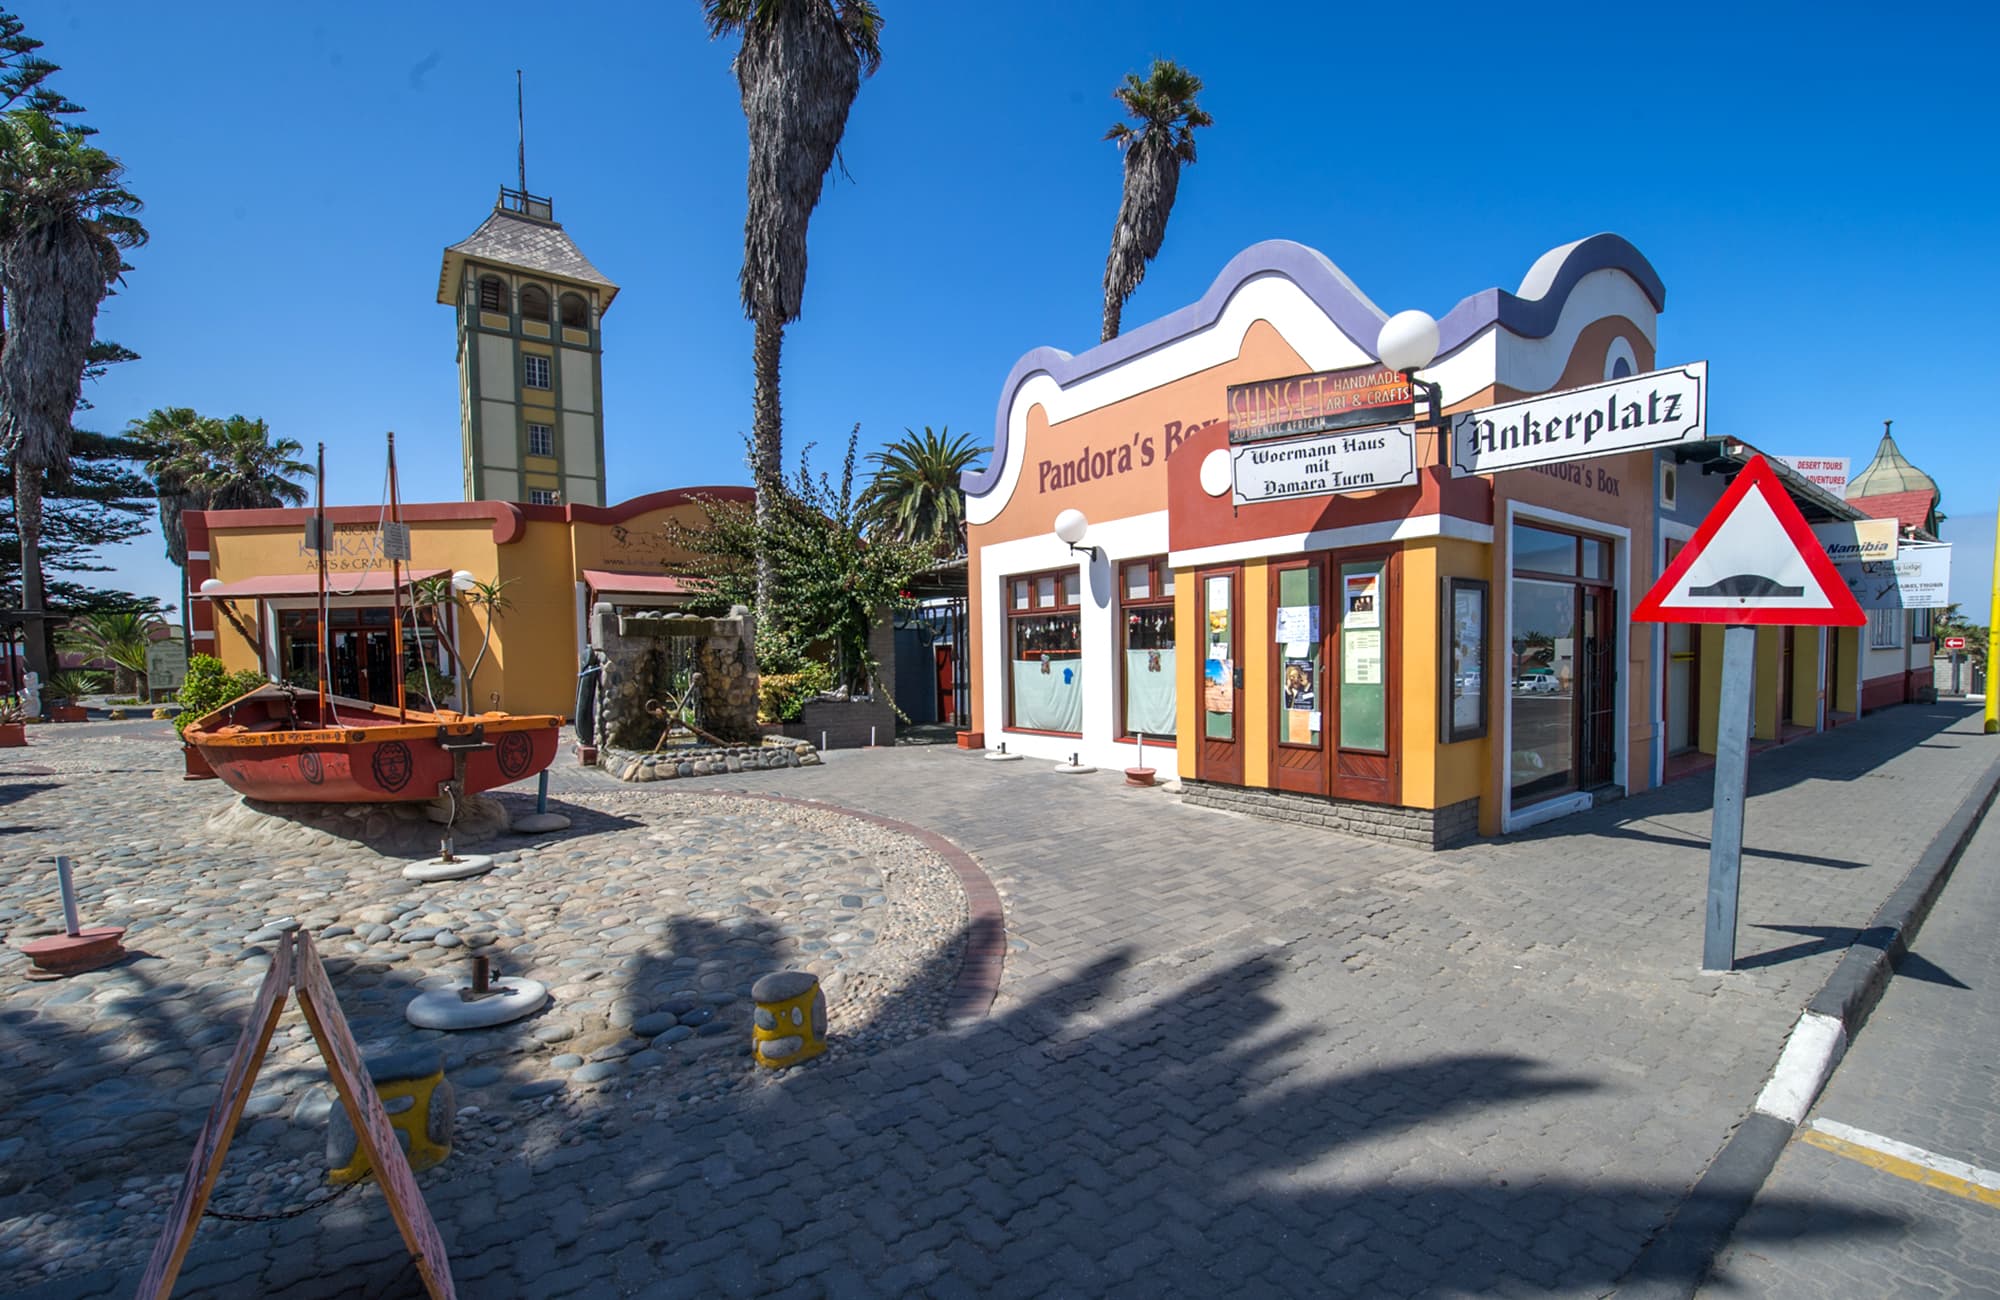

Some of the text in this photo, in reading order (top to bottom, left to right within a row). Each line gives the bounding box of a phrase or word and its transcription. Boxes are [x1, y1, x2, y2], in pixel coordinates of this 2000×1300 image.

[1334, 371, 1400, 392] HANDMADE
[1232, 376, 1328, 429] SUNSET
[1327, 386, 1410, 411] ART & CRAFTS
[1286, 416, 1326, 432] AFRICAN
[1469, 388, 1683, 457] Ankerplatz
[1038, 432, 1155, 495] Pandora's
[1251, 437, 1385, 465] Woermann Haus
[1305, 459, 1330, 475] mit
[1797, 460, 1843, 470] DESERT TOURS
[1263, 470, 1375, 496] Damara Turm
[1597, 467, 1620, 497] Box
[1827, 541, 1889, 554] Namibia
[340, 559, 350, 570] &
